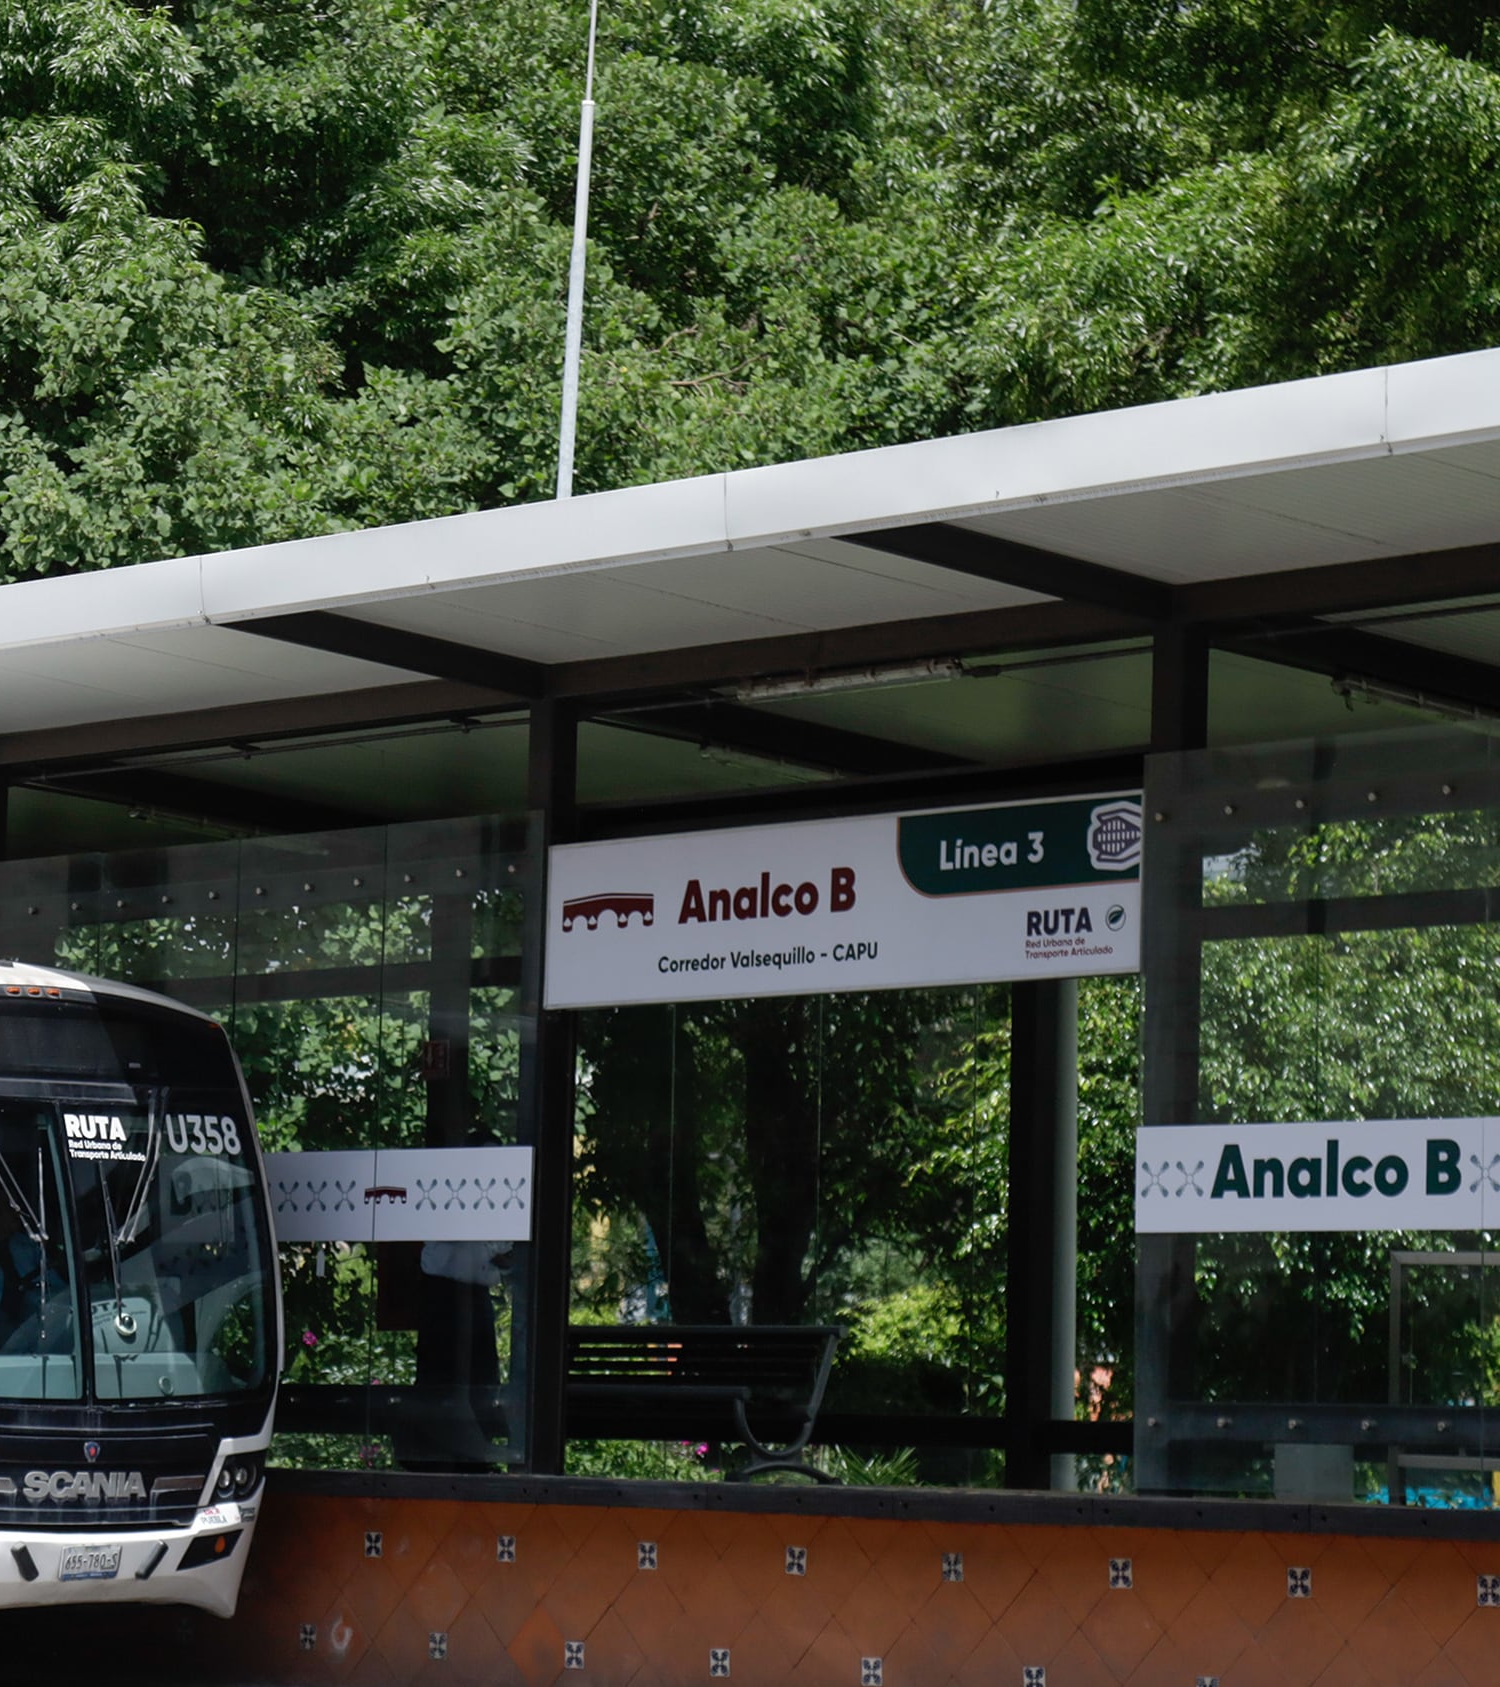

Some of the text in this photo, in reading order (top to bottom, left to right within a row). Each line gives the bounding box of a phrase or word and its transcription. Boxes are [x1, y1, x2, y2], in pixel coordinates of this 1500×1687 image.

[940, 831, 1045, 871] Línea 3
[678, 867, 856, 924] Analco B
[1026, 907, 1093, 937] RUTA
[658, 954, 726, 973] Corredor
[730, 946, 815, 970] Valsequillo
[832, 941, 878, 962] CAPU
[1025, 937, 1086, 949] Red Urbana de
[1025, 944, 1114, 960] Transporte Articulado
[63, 1113, 127, 1141] RUTA
[165, 1114, 241, 1156] U358
[68, 1139, 123, 1150] Red Urbana de
[69, 1149, 146, 1162] Transporte Articulado
[1210, 1138, 1462, 1199] Analco B
[23, 1471, 147, 1499] SCANIA
